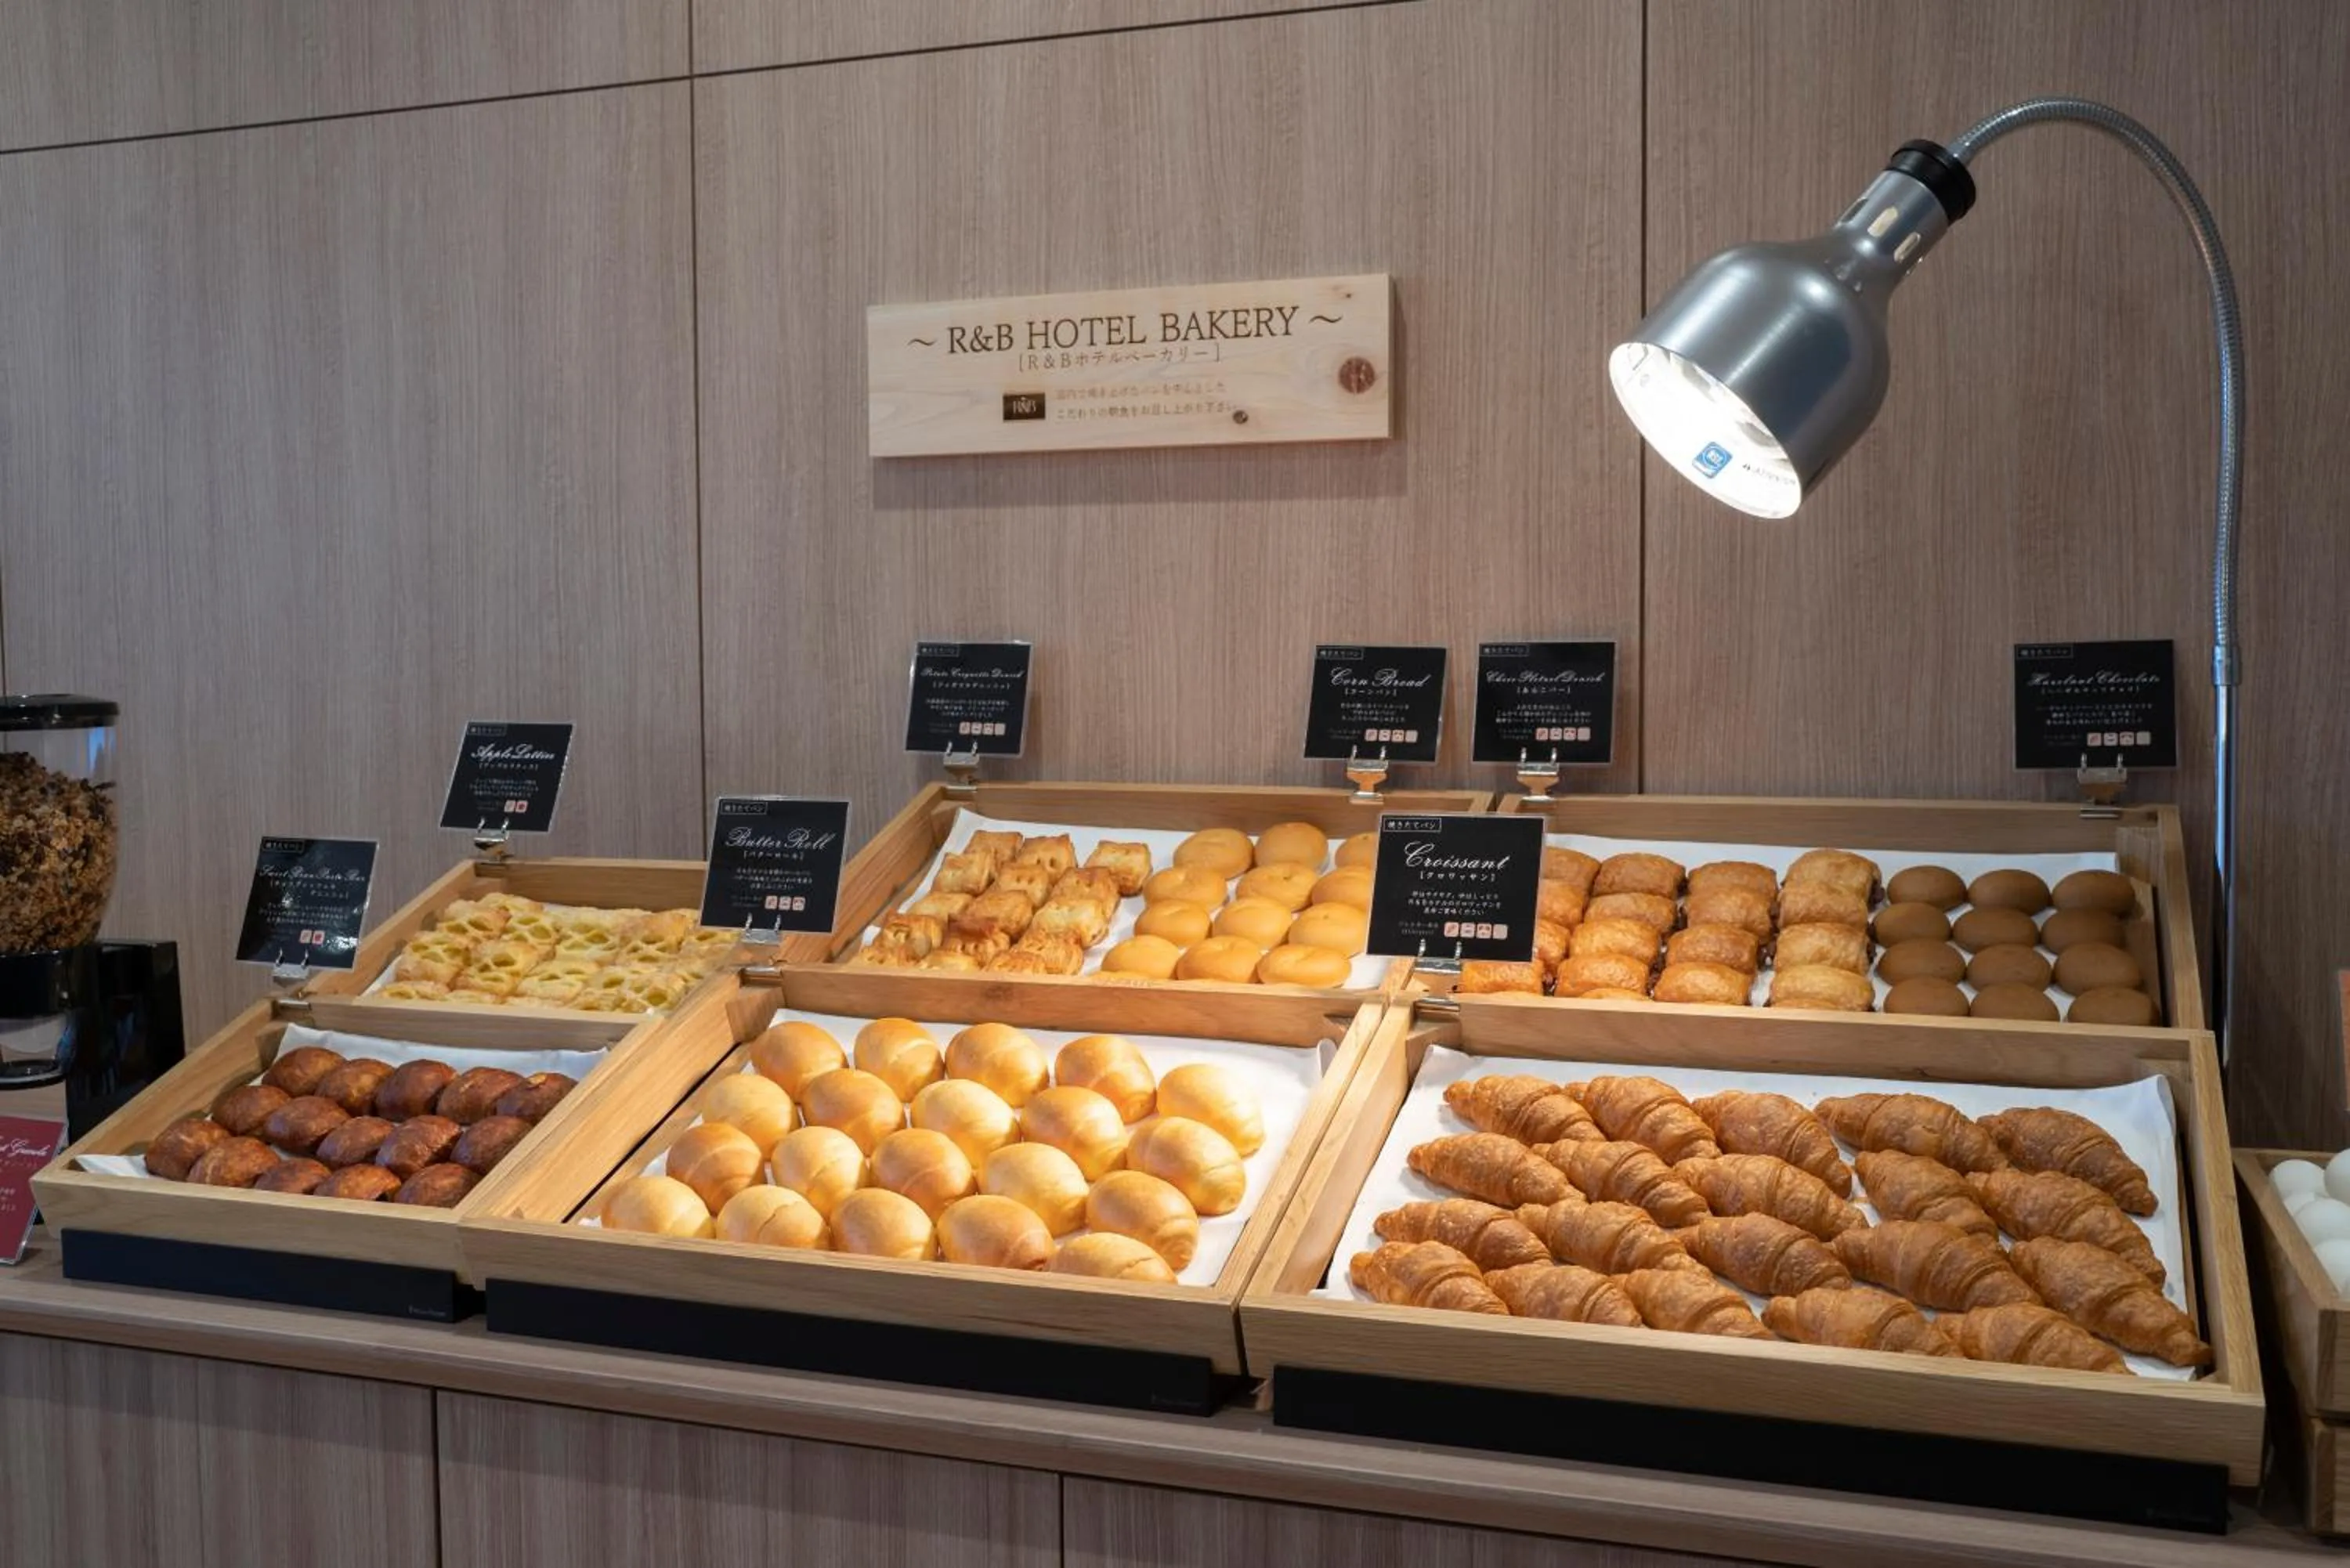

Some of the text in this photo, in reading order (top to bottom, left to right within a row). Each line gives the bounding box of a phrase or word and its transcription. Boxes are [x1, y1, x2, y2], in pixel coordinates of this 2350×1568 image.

[946, 324, 1014, 354] R&B
[1027, 313, 1148, 351] HOTEL
[1159, 305, 1300, 343] BAKERY
[1330, 667, 1432, 688] Corn Bread
[725, 826, 837, 851] Butter Roll
[1403, 840, 1511, 871] Croissant
